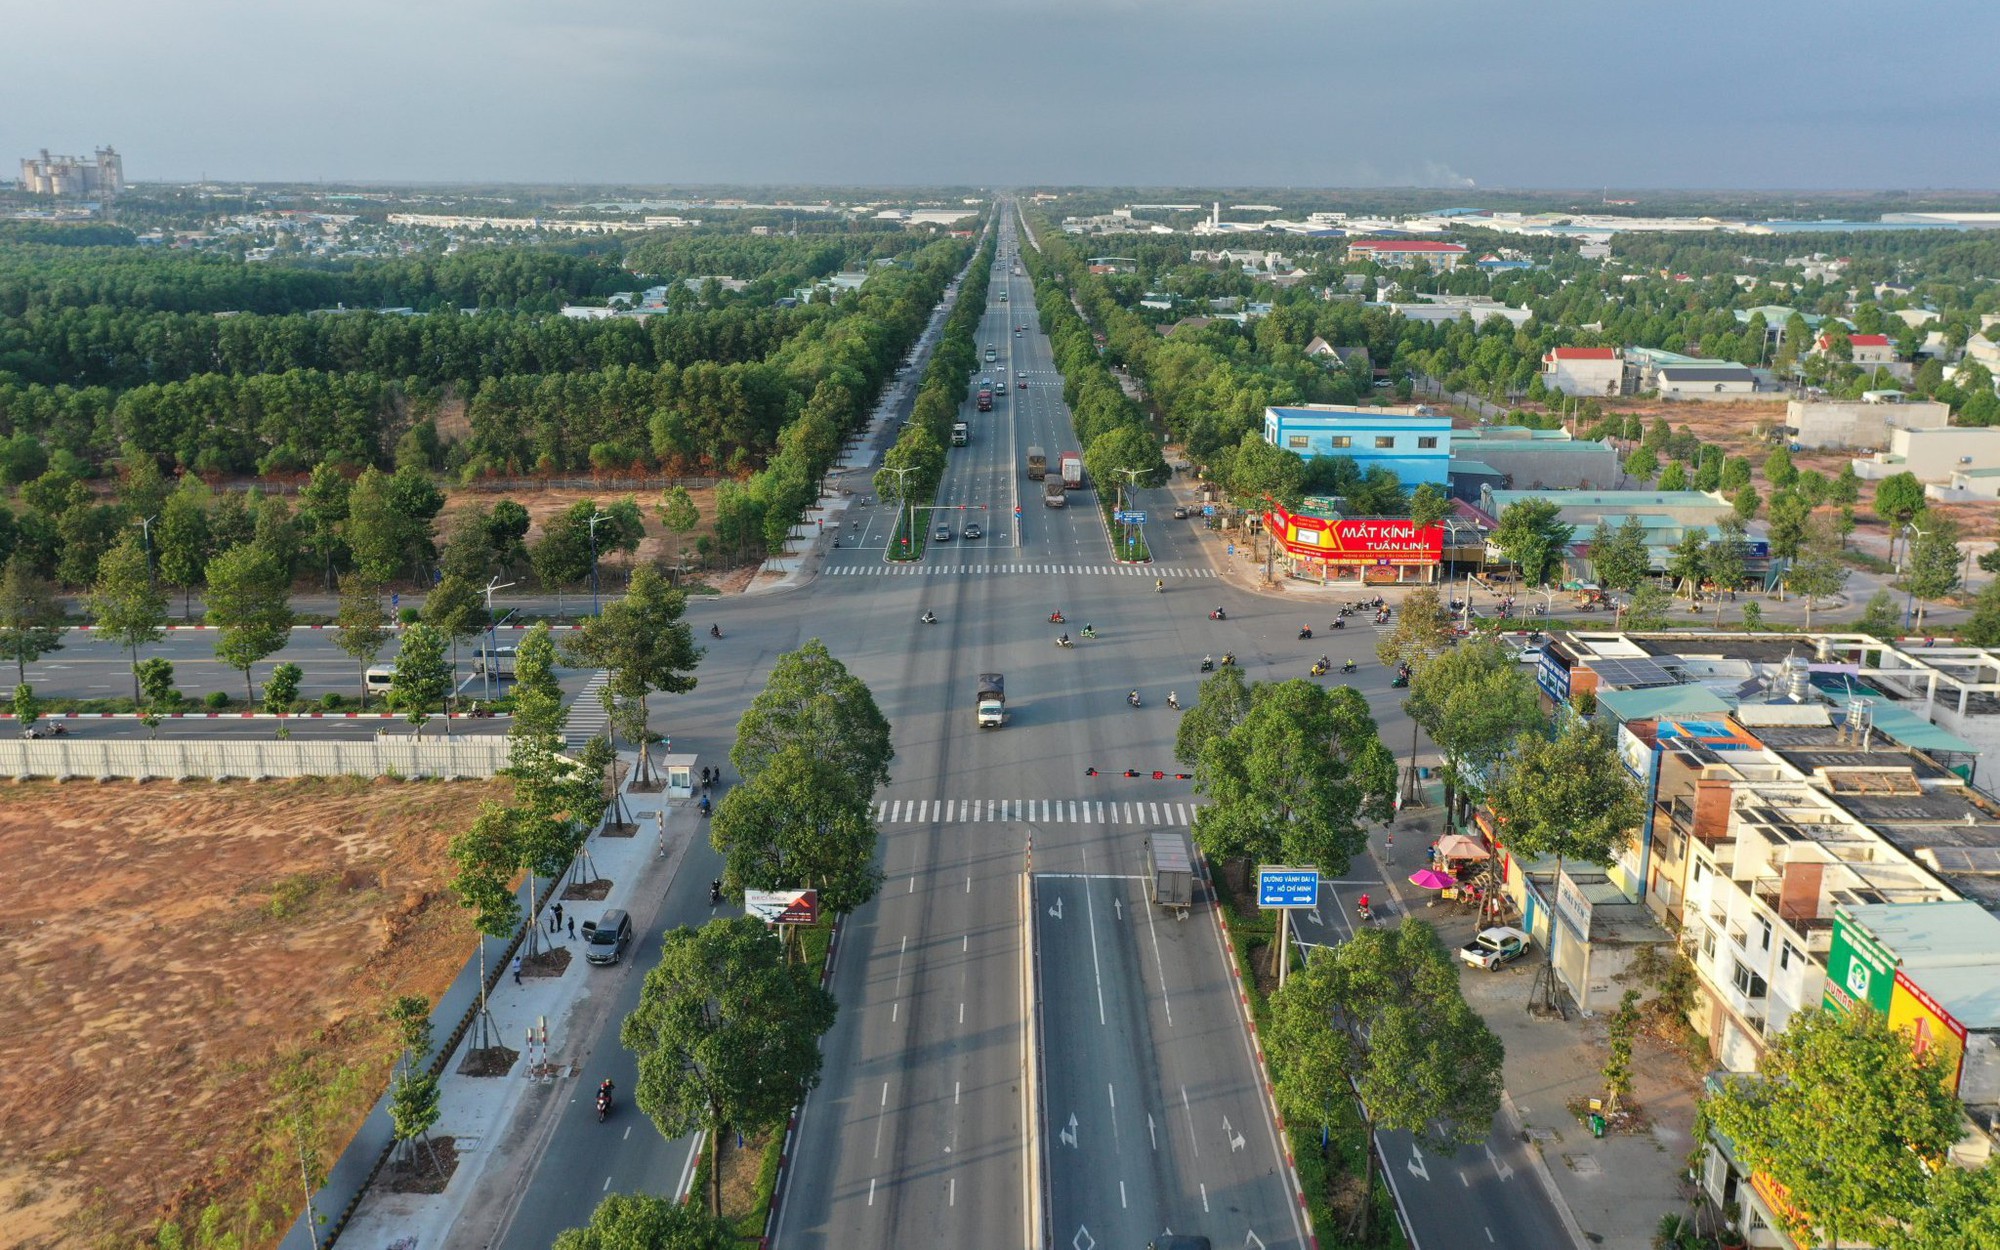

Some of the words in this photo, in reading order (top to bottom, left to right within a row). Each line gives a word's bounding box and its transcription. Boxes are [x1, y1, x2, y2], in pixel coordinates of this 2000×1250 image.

[1342, 522, 1377, 538] MẮT
[1381, 525, 1415, 538] KÍNH
[1366, 538, 1400, 550] TUẤN
[1402, 542, 1430, 550] LINH
[1286, 884, 1296, 892] CHÍ
